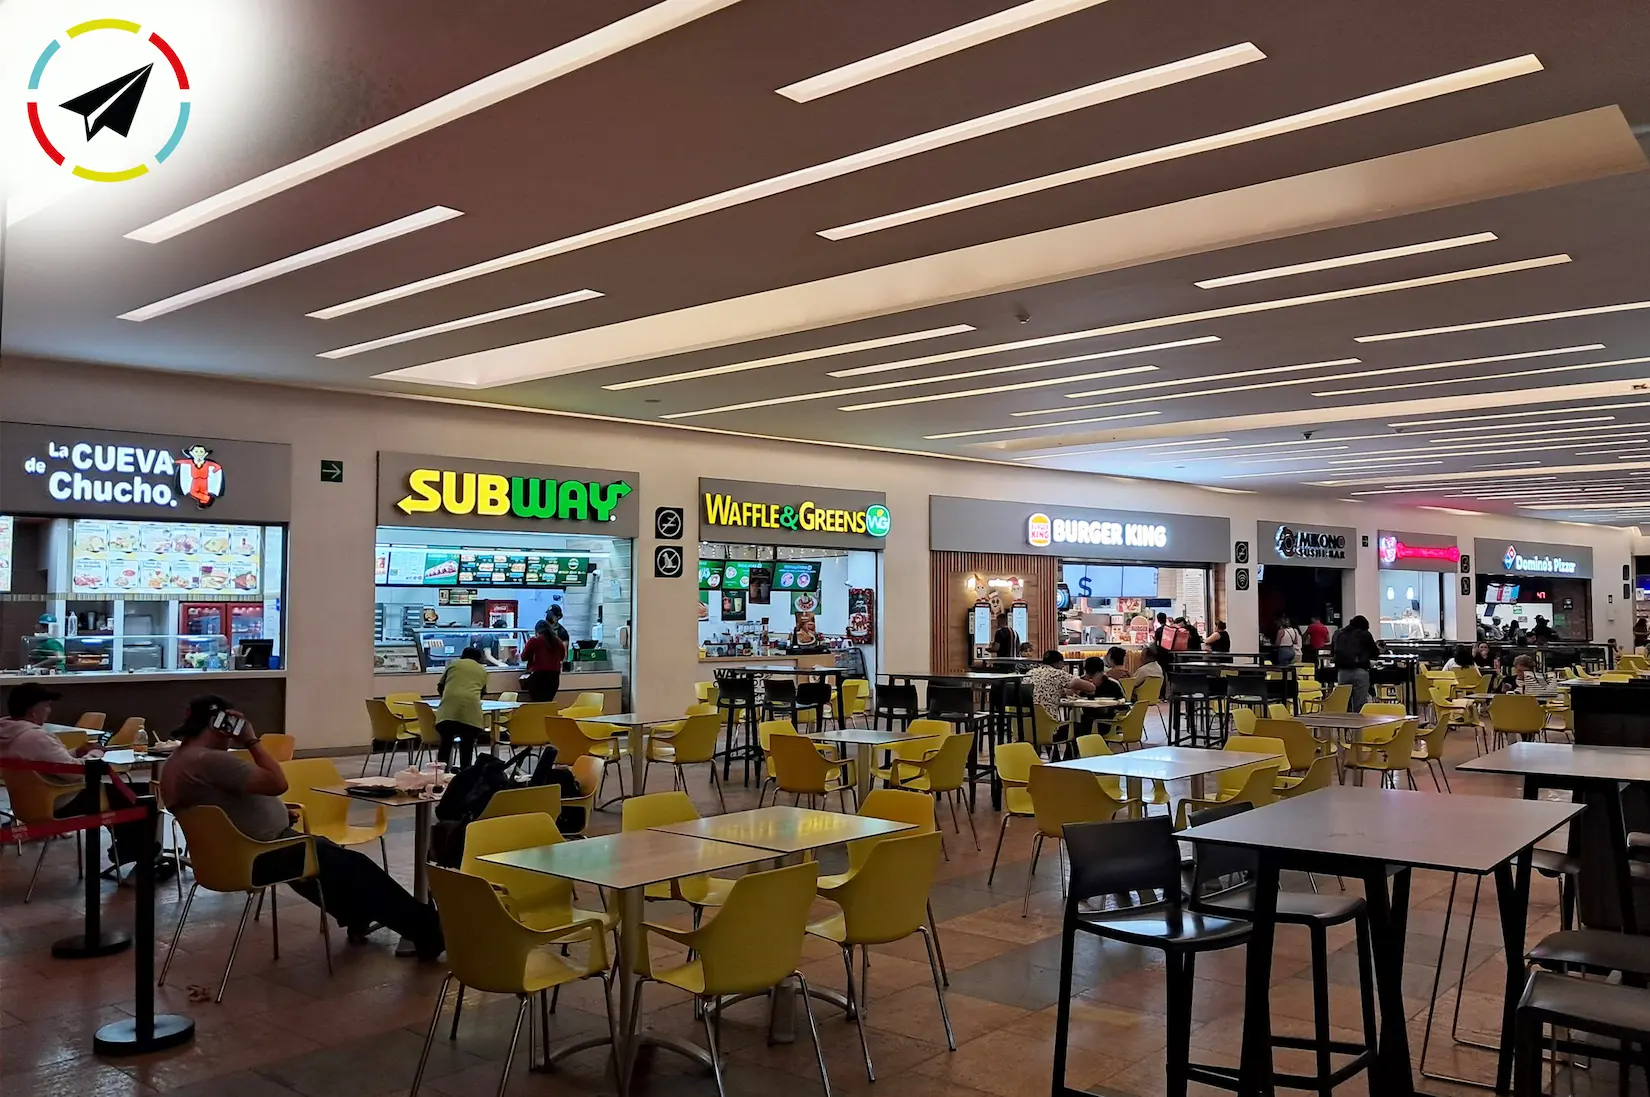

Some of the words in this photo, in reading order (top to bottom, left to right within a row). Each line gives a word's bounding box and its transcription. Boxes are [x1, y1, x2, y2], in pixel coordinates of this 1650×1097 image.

[24, 457, 46, 474] de
[48, 441, 69, 458] La
[72, 443, 174, 475] CUEVA
[396, 468, 633, 521] SUBWAY
[1031, 530, 1050, 539] KING
[1052, 518, 1123, 546] BURGER
[1125, 523, 1167, 548] KING
[1515, 554, 1553, 572] Domino's
[1553, 557, 1576, 574] Pizza
